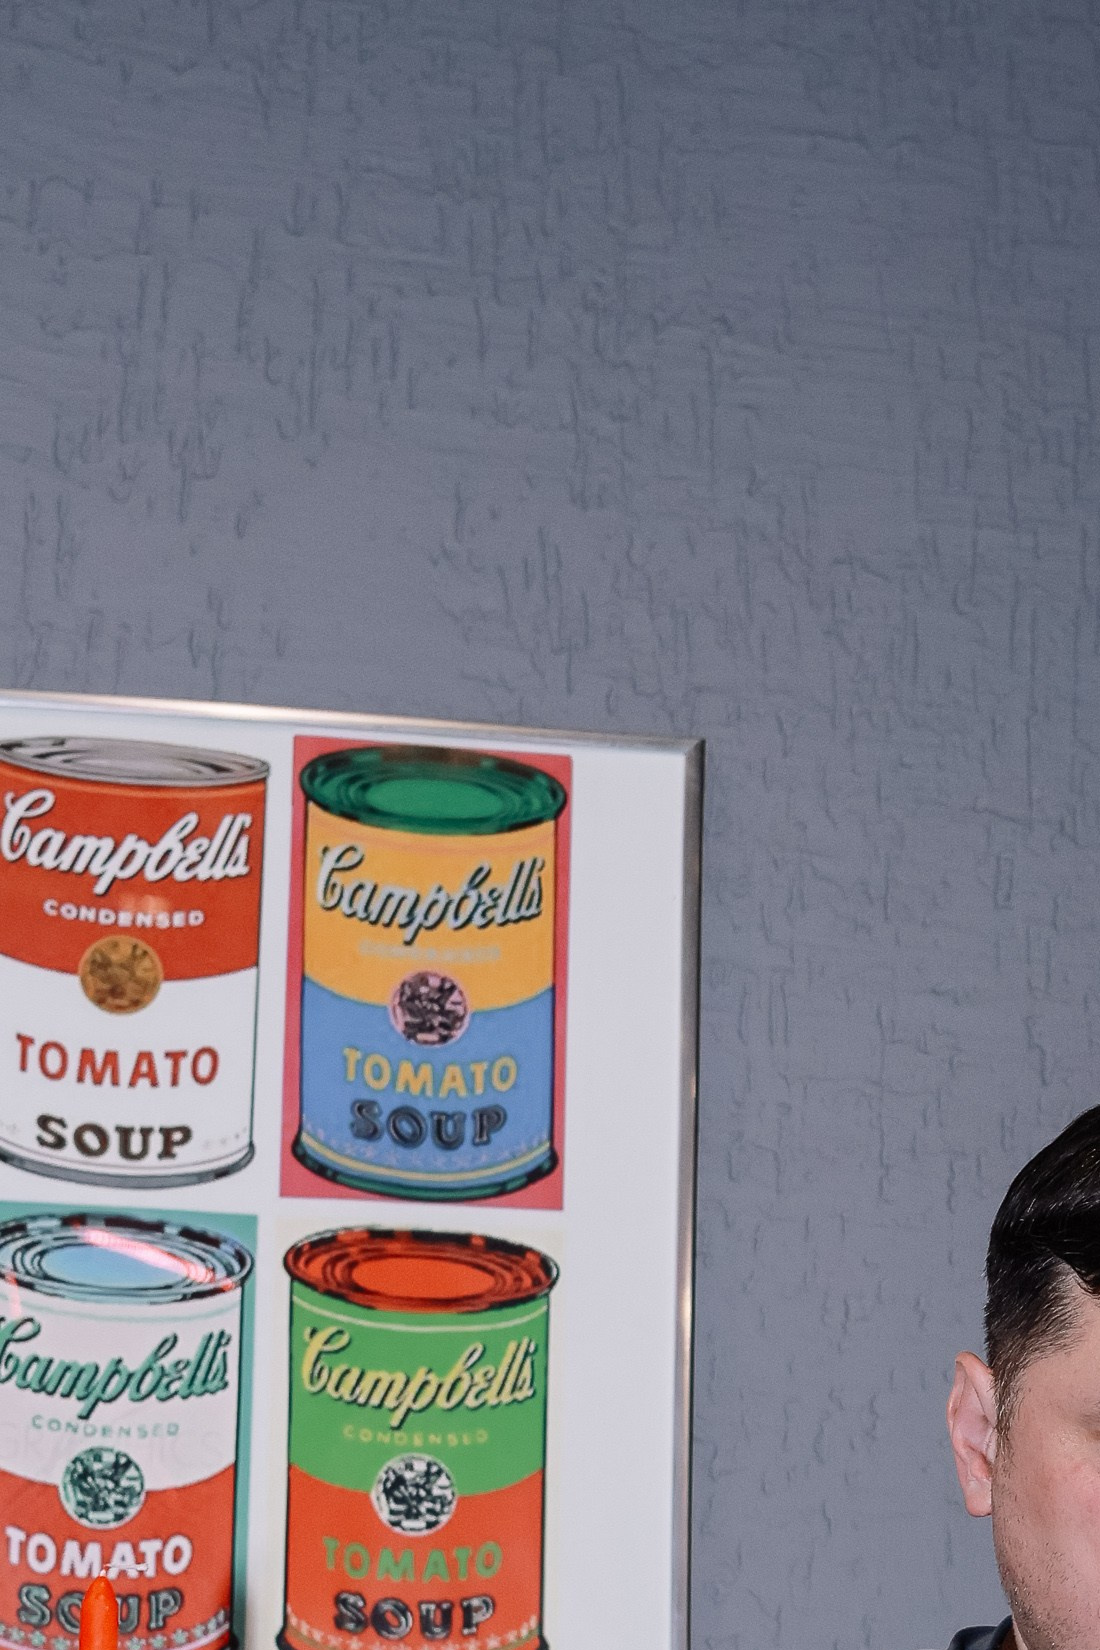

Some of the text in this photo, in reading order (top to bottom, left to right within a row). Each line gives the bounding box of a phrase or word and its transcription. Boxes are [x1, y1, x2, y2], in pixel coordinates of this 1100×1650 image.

[43, 899, 205, 928] CONDENSED
[16, 1033, 219, 1088] TOMATO
[343, 1046, 518, 1098] TOMATO
[36, 1114, 193, 1162] SOUP
[350, 1099, 508, 1151] SOUP
[30, 1413, 181, 1440] CONDENSED
[342, 1425, 490, 1448] CONDENSED
[4, 1526, 193, 1580] TOMATO
[322, 1537, 503, 1583] TOMATO
[334, 1592, 495, 1640] SOUP
